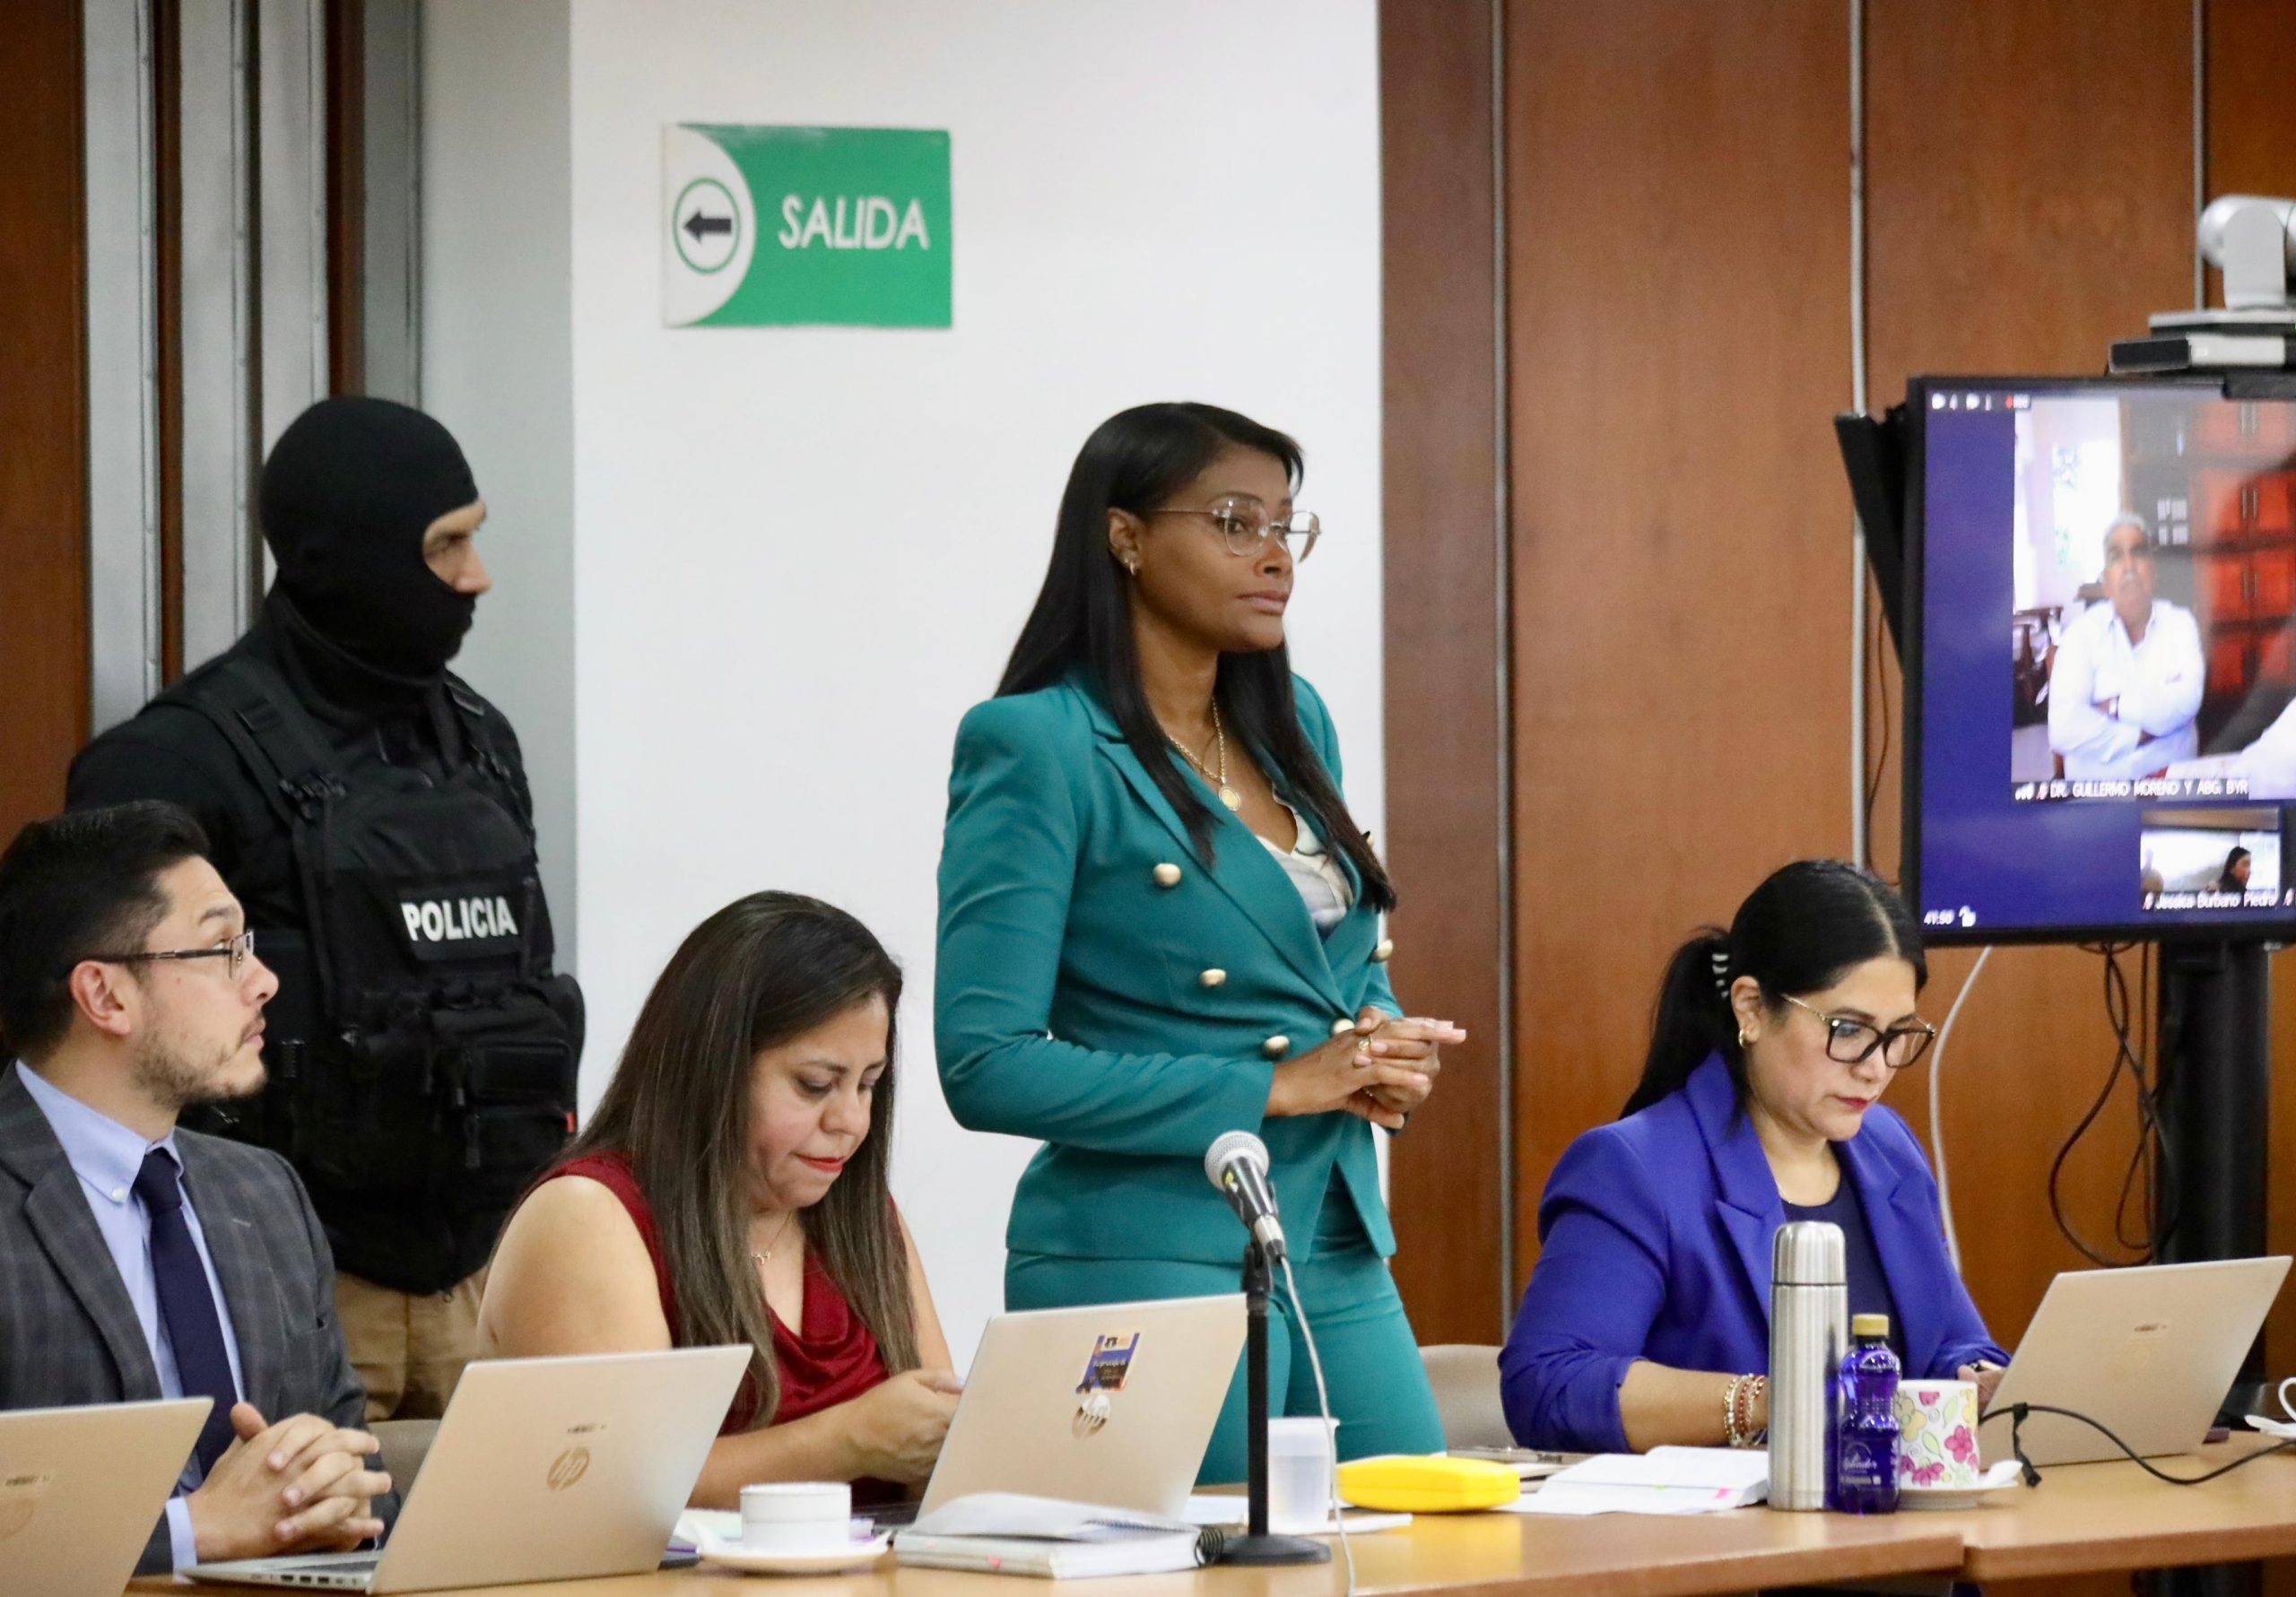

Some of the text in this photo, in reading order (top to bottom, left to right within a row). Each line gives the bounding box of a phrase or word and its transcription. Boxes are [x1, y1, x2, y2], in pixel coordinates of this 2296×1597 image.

[778, 194, 930, 250] SALIDA
[2134, 779, 2180, 796] MORENO
[2184, 779, 2194, 796] Y
[401, 896, 518, 942] POLICIA
